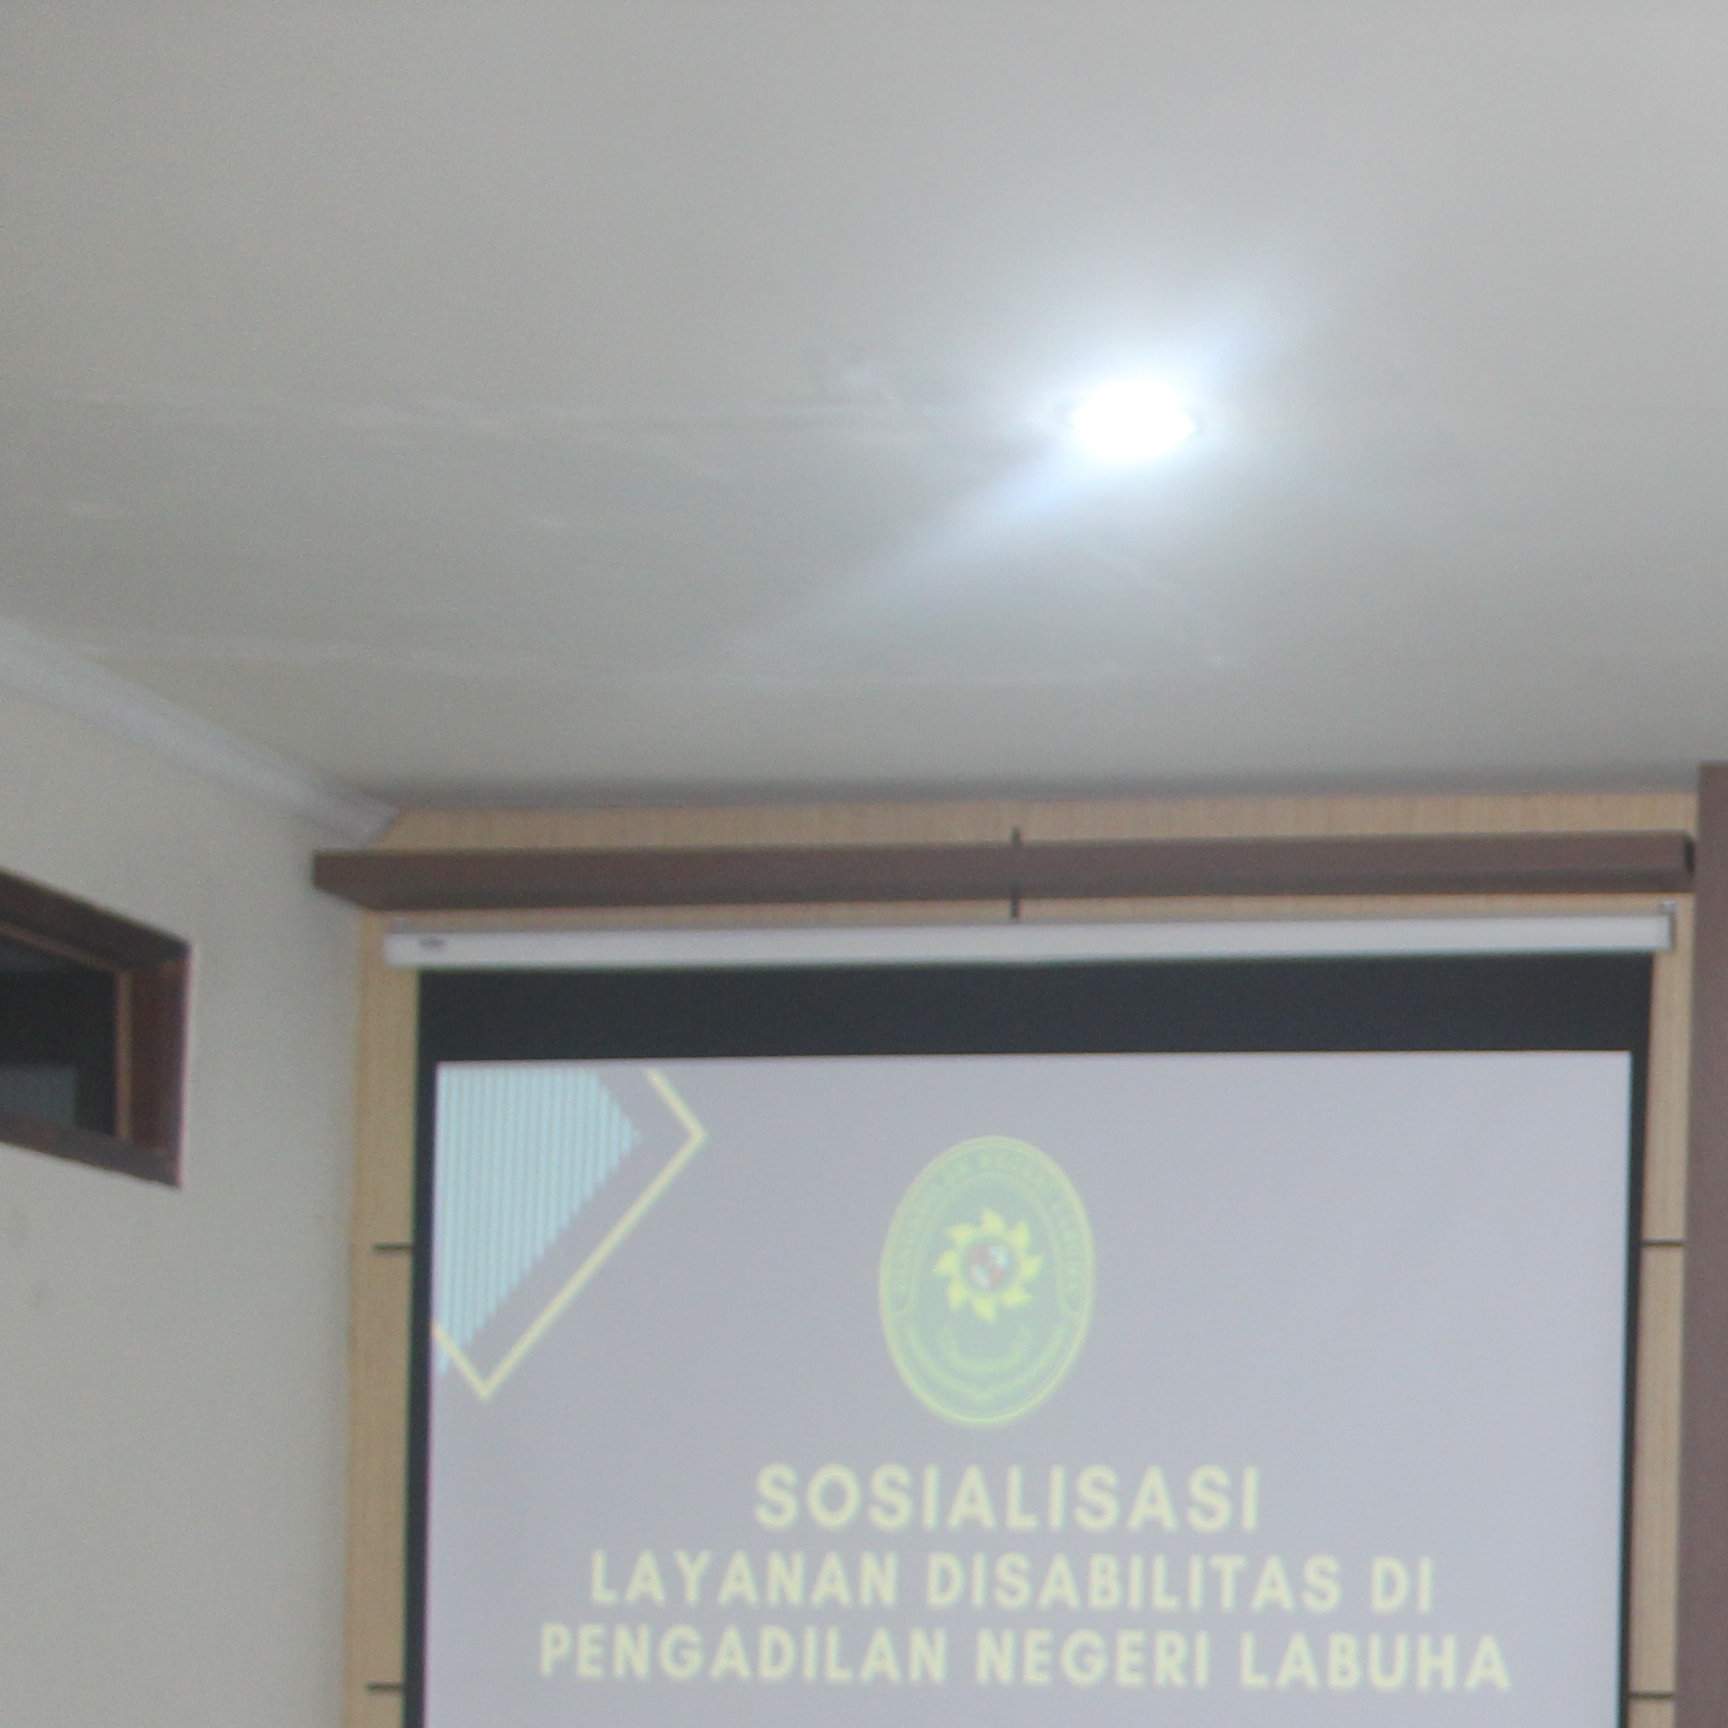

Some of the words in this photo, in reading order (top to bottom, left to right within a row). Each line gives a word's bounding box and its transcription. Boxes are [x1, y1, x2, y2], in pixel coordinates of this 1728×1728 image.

[752, 1464, 1260, 1534] SOSIALISASI
[589, 1549, 898, 1609] LAYANAN
[926, 1553, 1342, 1612] DISABILITAS
[1371, 1556, 1435, 1614] DI
[539, 1623, 948, 1685] PENGADILAN
[975, 1628, 1211, 1688] NEGERI
[1238, 1632, 1512, 1693] LABUHA
